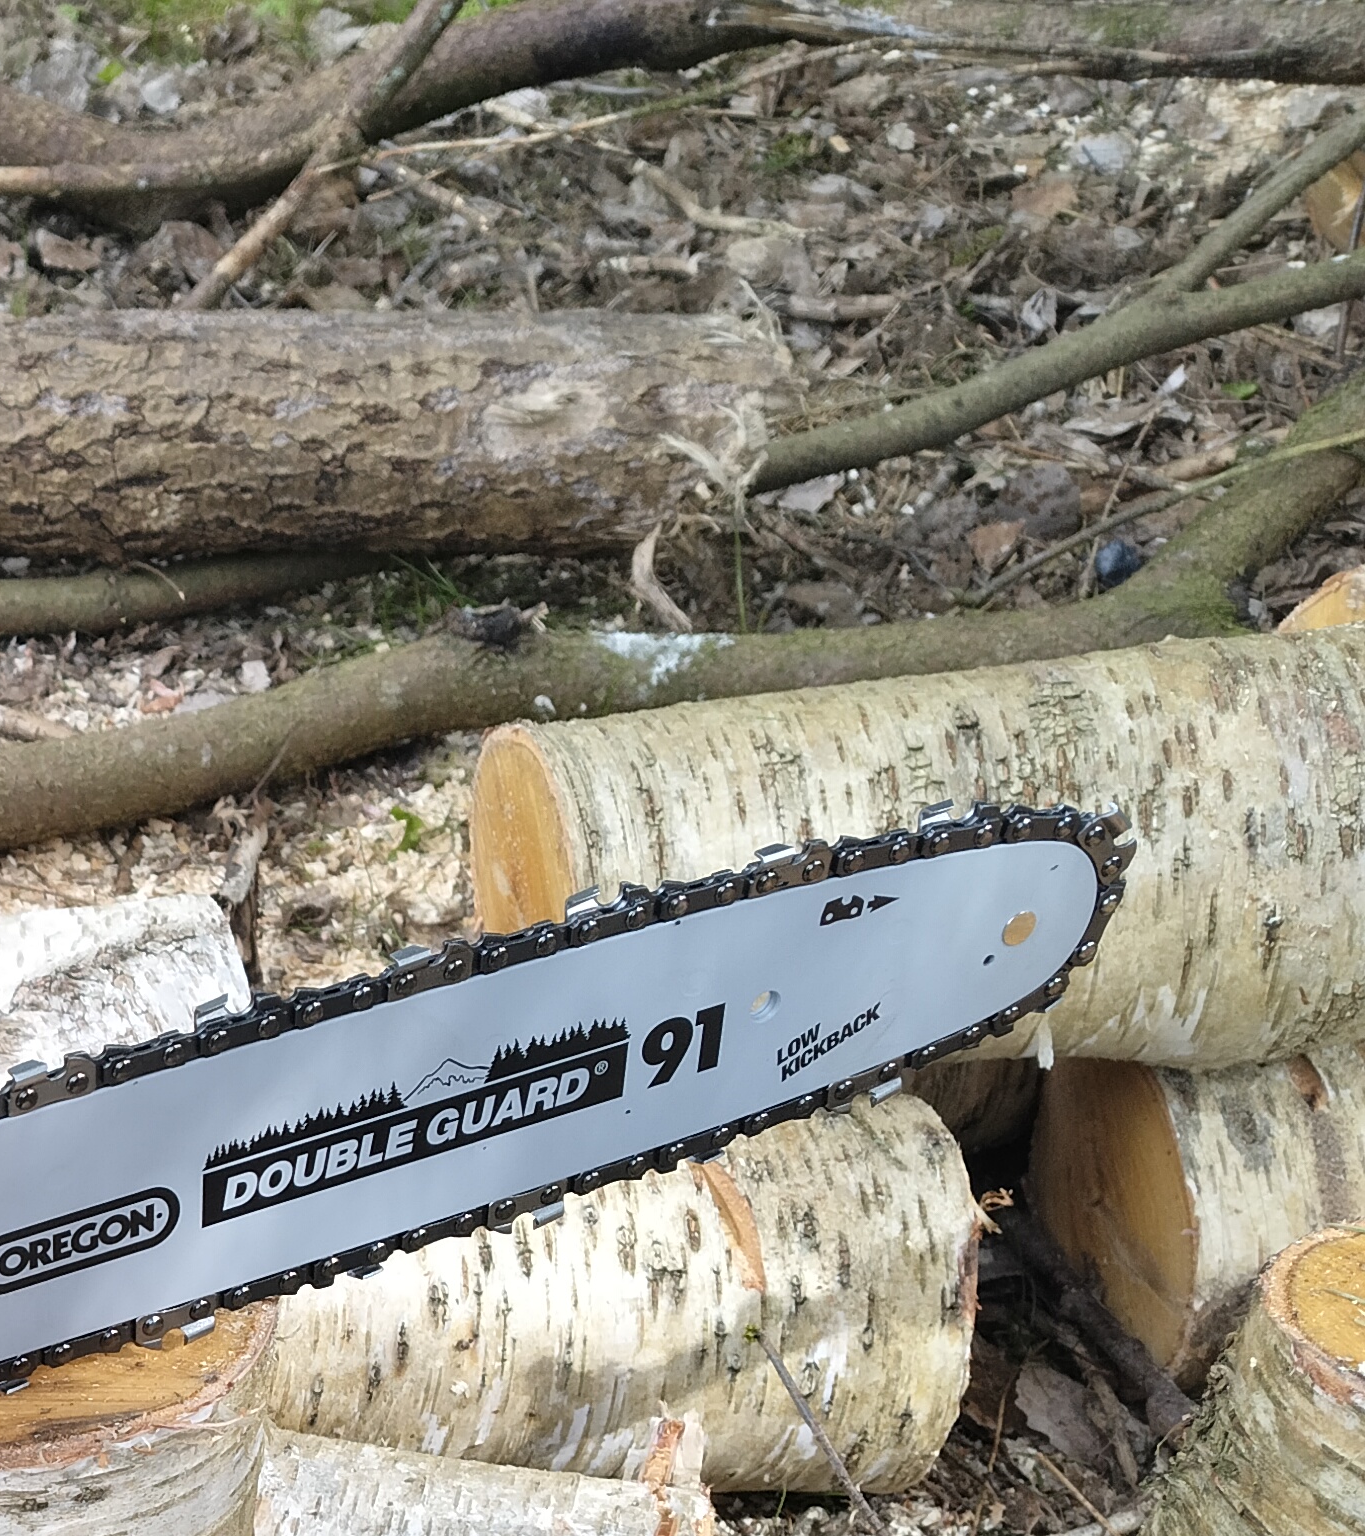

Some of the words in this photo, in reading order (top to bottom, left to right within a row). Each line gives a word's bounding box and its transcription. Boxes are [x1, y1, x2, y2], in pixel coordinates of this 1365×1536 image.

[642, 1003, 727, 1089] 91
[776, 1023, 820, 1066] LOW
[781, 1001, 881, 1082] KICKBACK
[223, 1118, 418, 1211] DOUBLE
